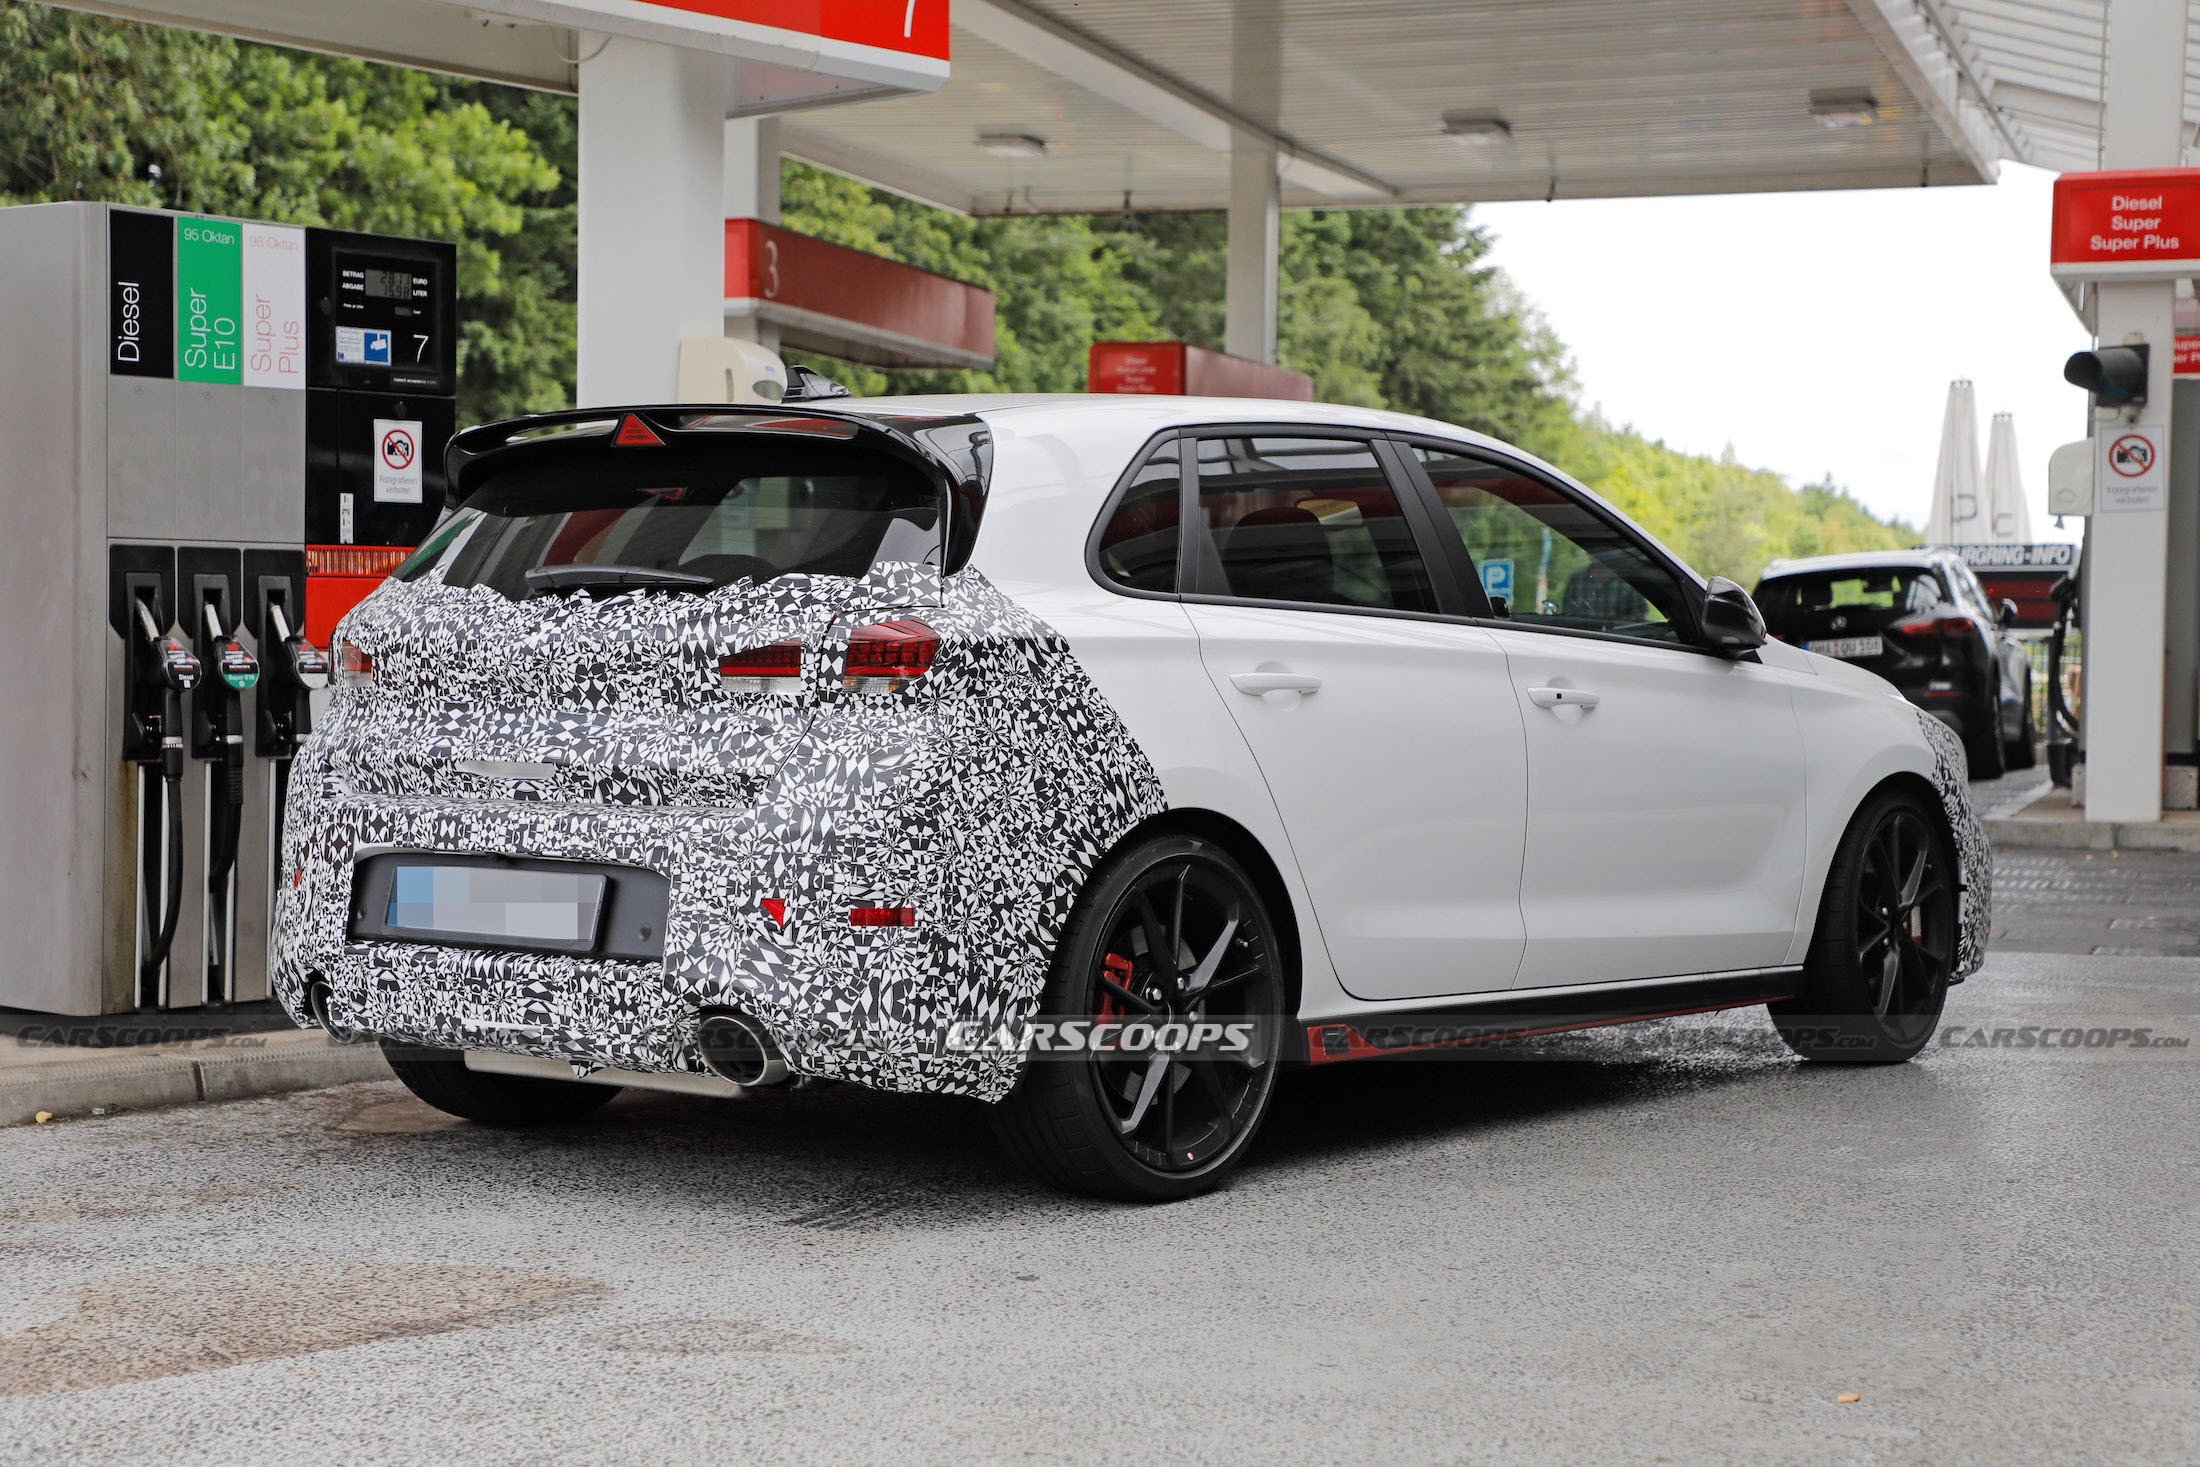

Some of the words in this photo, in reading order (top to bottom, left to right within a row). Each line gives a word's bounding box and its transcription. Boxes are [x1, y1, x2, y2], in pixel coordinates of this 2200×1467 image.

[2111, 195, 2163, 211] Diesel
[2111, 215, 2161, 232] Super
[183, 227, 200, 241] 95
[201, 229, 236, 245] Oktan
[249, 234, 264, 248] 98
[266, 236, 298, 251] Oktan
[2090, 234, 2140, 252] Super
[2143, 234, 2180, 250] Plus
[764, 240, 780, 299] 3
[117, 281, 140, 363] Diesel
[184, 287, 212, 369] Super
[250, 293, 277, 373] Super
[213, 317, 236, 370] E10
[278, 320, 300, 374] Plus
[413, 333, 430, 363] 7
